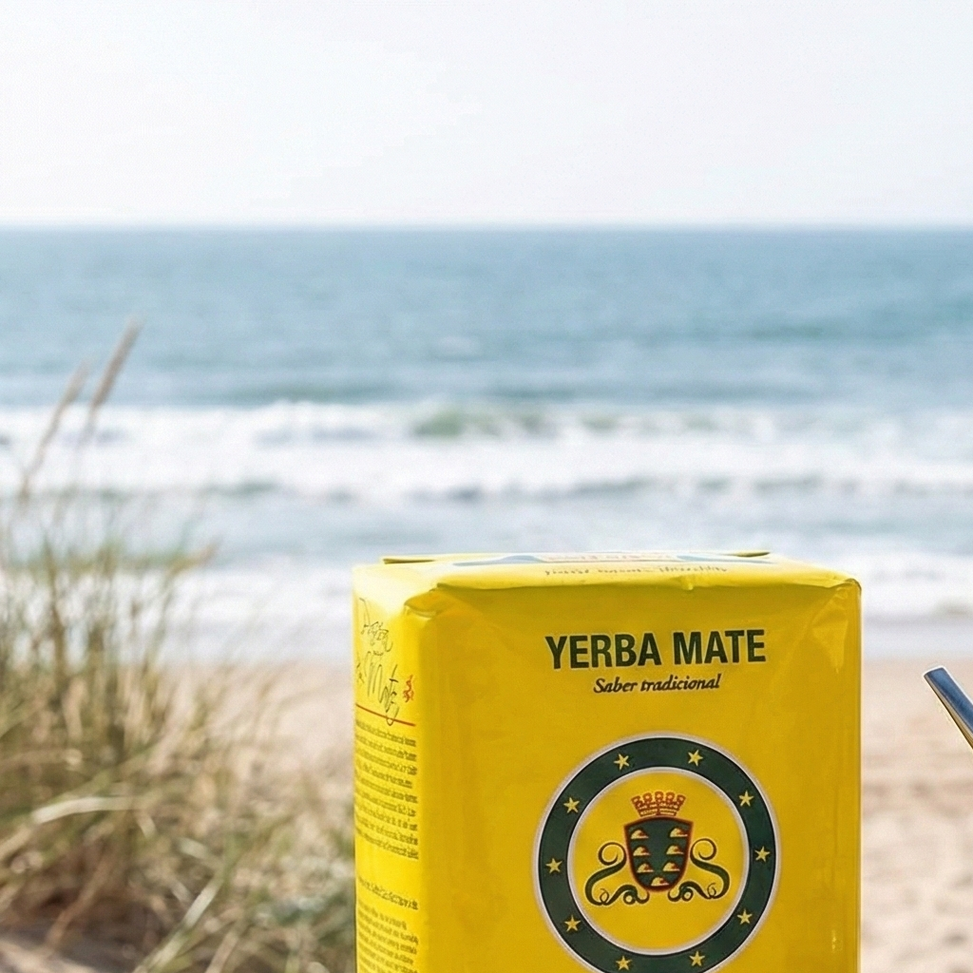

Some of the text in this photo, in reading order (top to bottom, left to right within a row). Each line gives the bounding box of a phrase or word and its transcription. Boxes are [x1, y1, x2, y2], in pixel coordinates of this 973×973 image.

[545, 629, 766, 669] YERBA MATE
[593, 673, 722, 694] Saber tradicional
